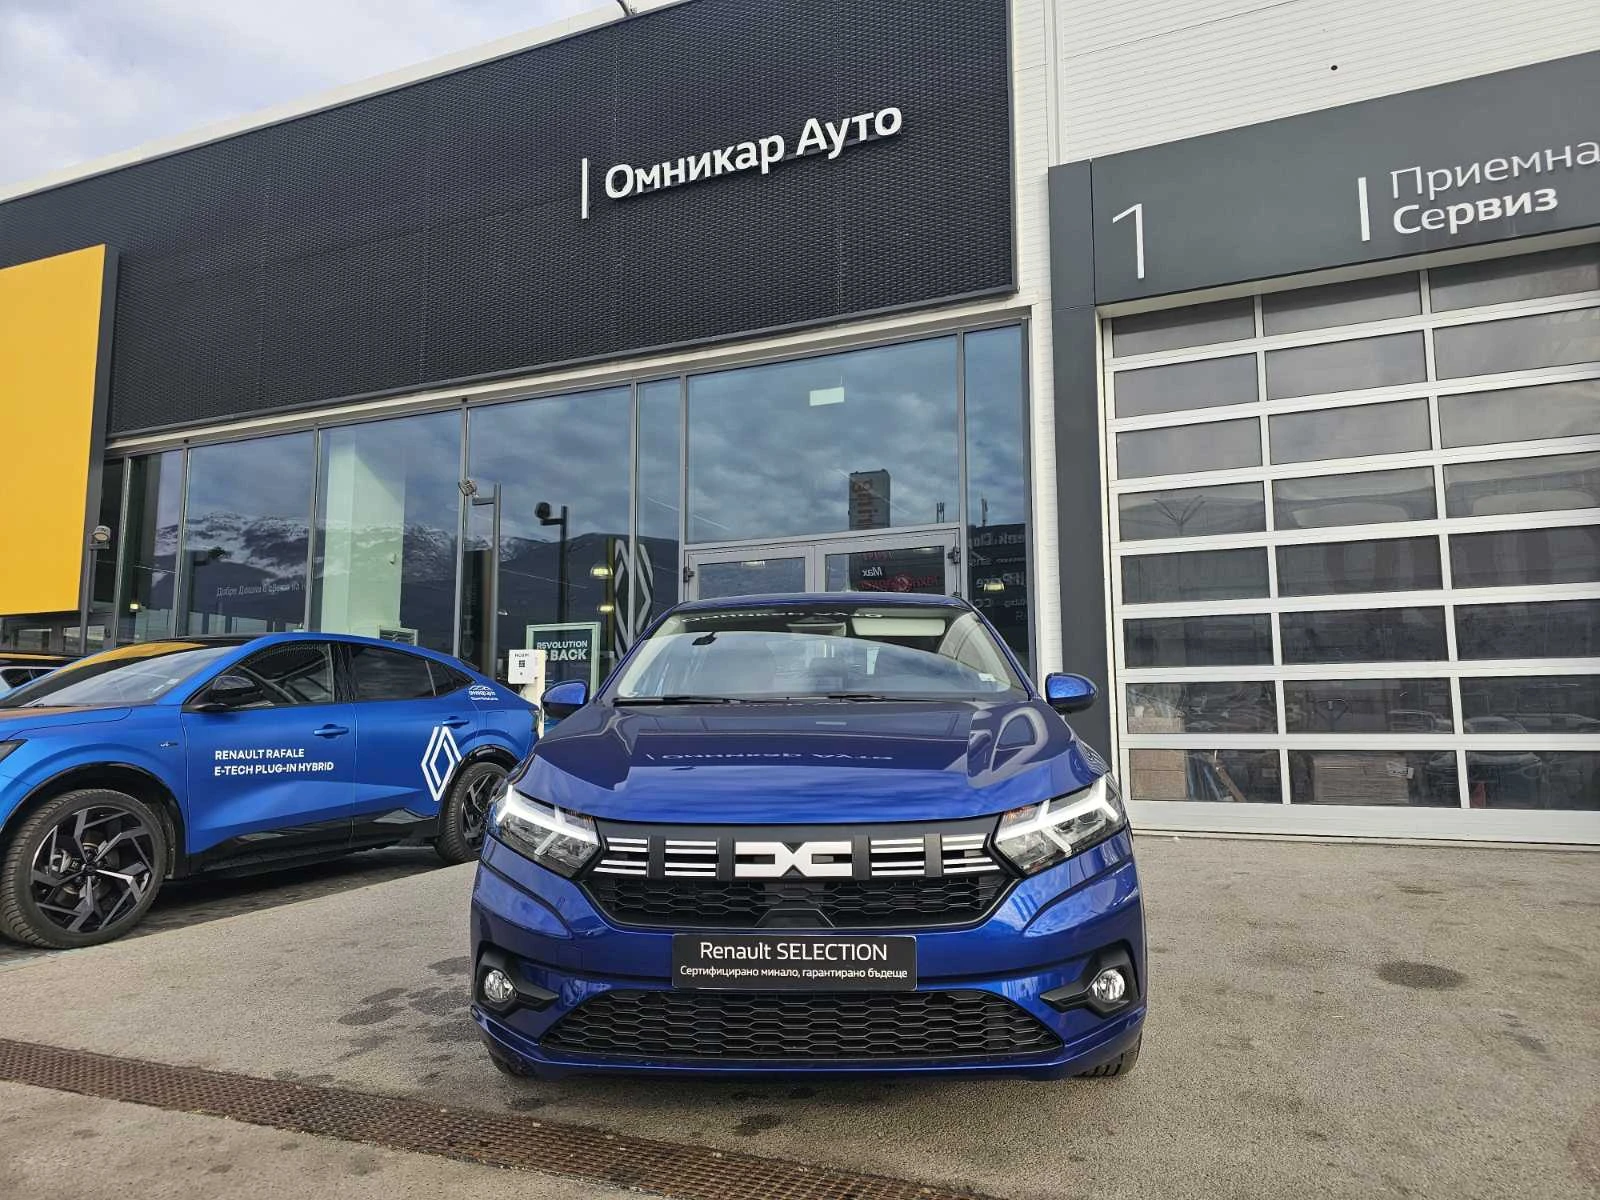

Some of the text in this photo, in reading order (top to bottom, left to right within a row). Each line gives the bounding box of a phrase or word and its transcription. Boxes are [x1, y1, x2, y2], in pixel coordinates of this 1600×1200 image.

[605, 107, 903, 199] Омникар Ауто
[1390, 141, 1600, 200] Приемна
[1393, 188, 1558, 234] Сервиз
[1112, 203, 1145, 279] 1
[550, 648, 587, 662] BACK
[215, 748, 305, 760] RENAULT RAFALE
[214, 761, 334, 776] E-TECH PLUG-IN HYBRID
[700, 942, 888, 961] Renault SELECTION
[680, 965, 908, 979] Сертифицирано минало, гарантирано бъдеще
